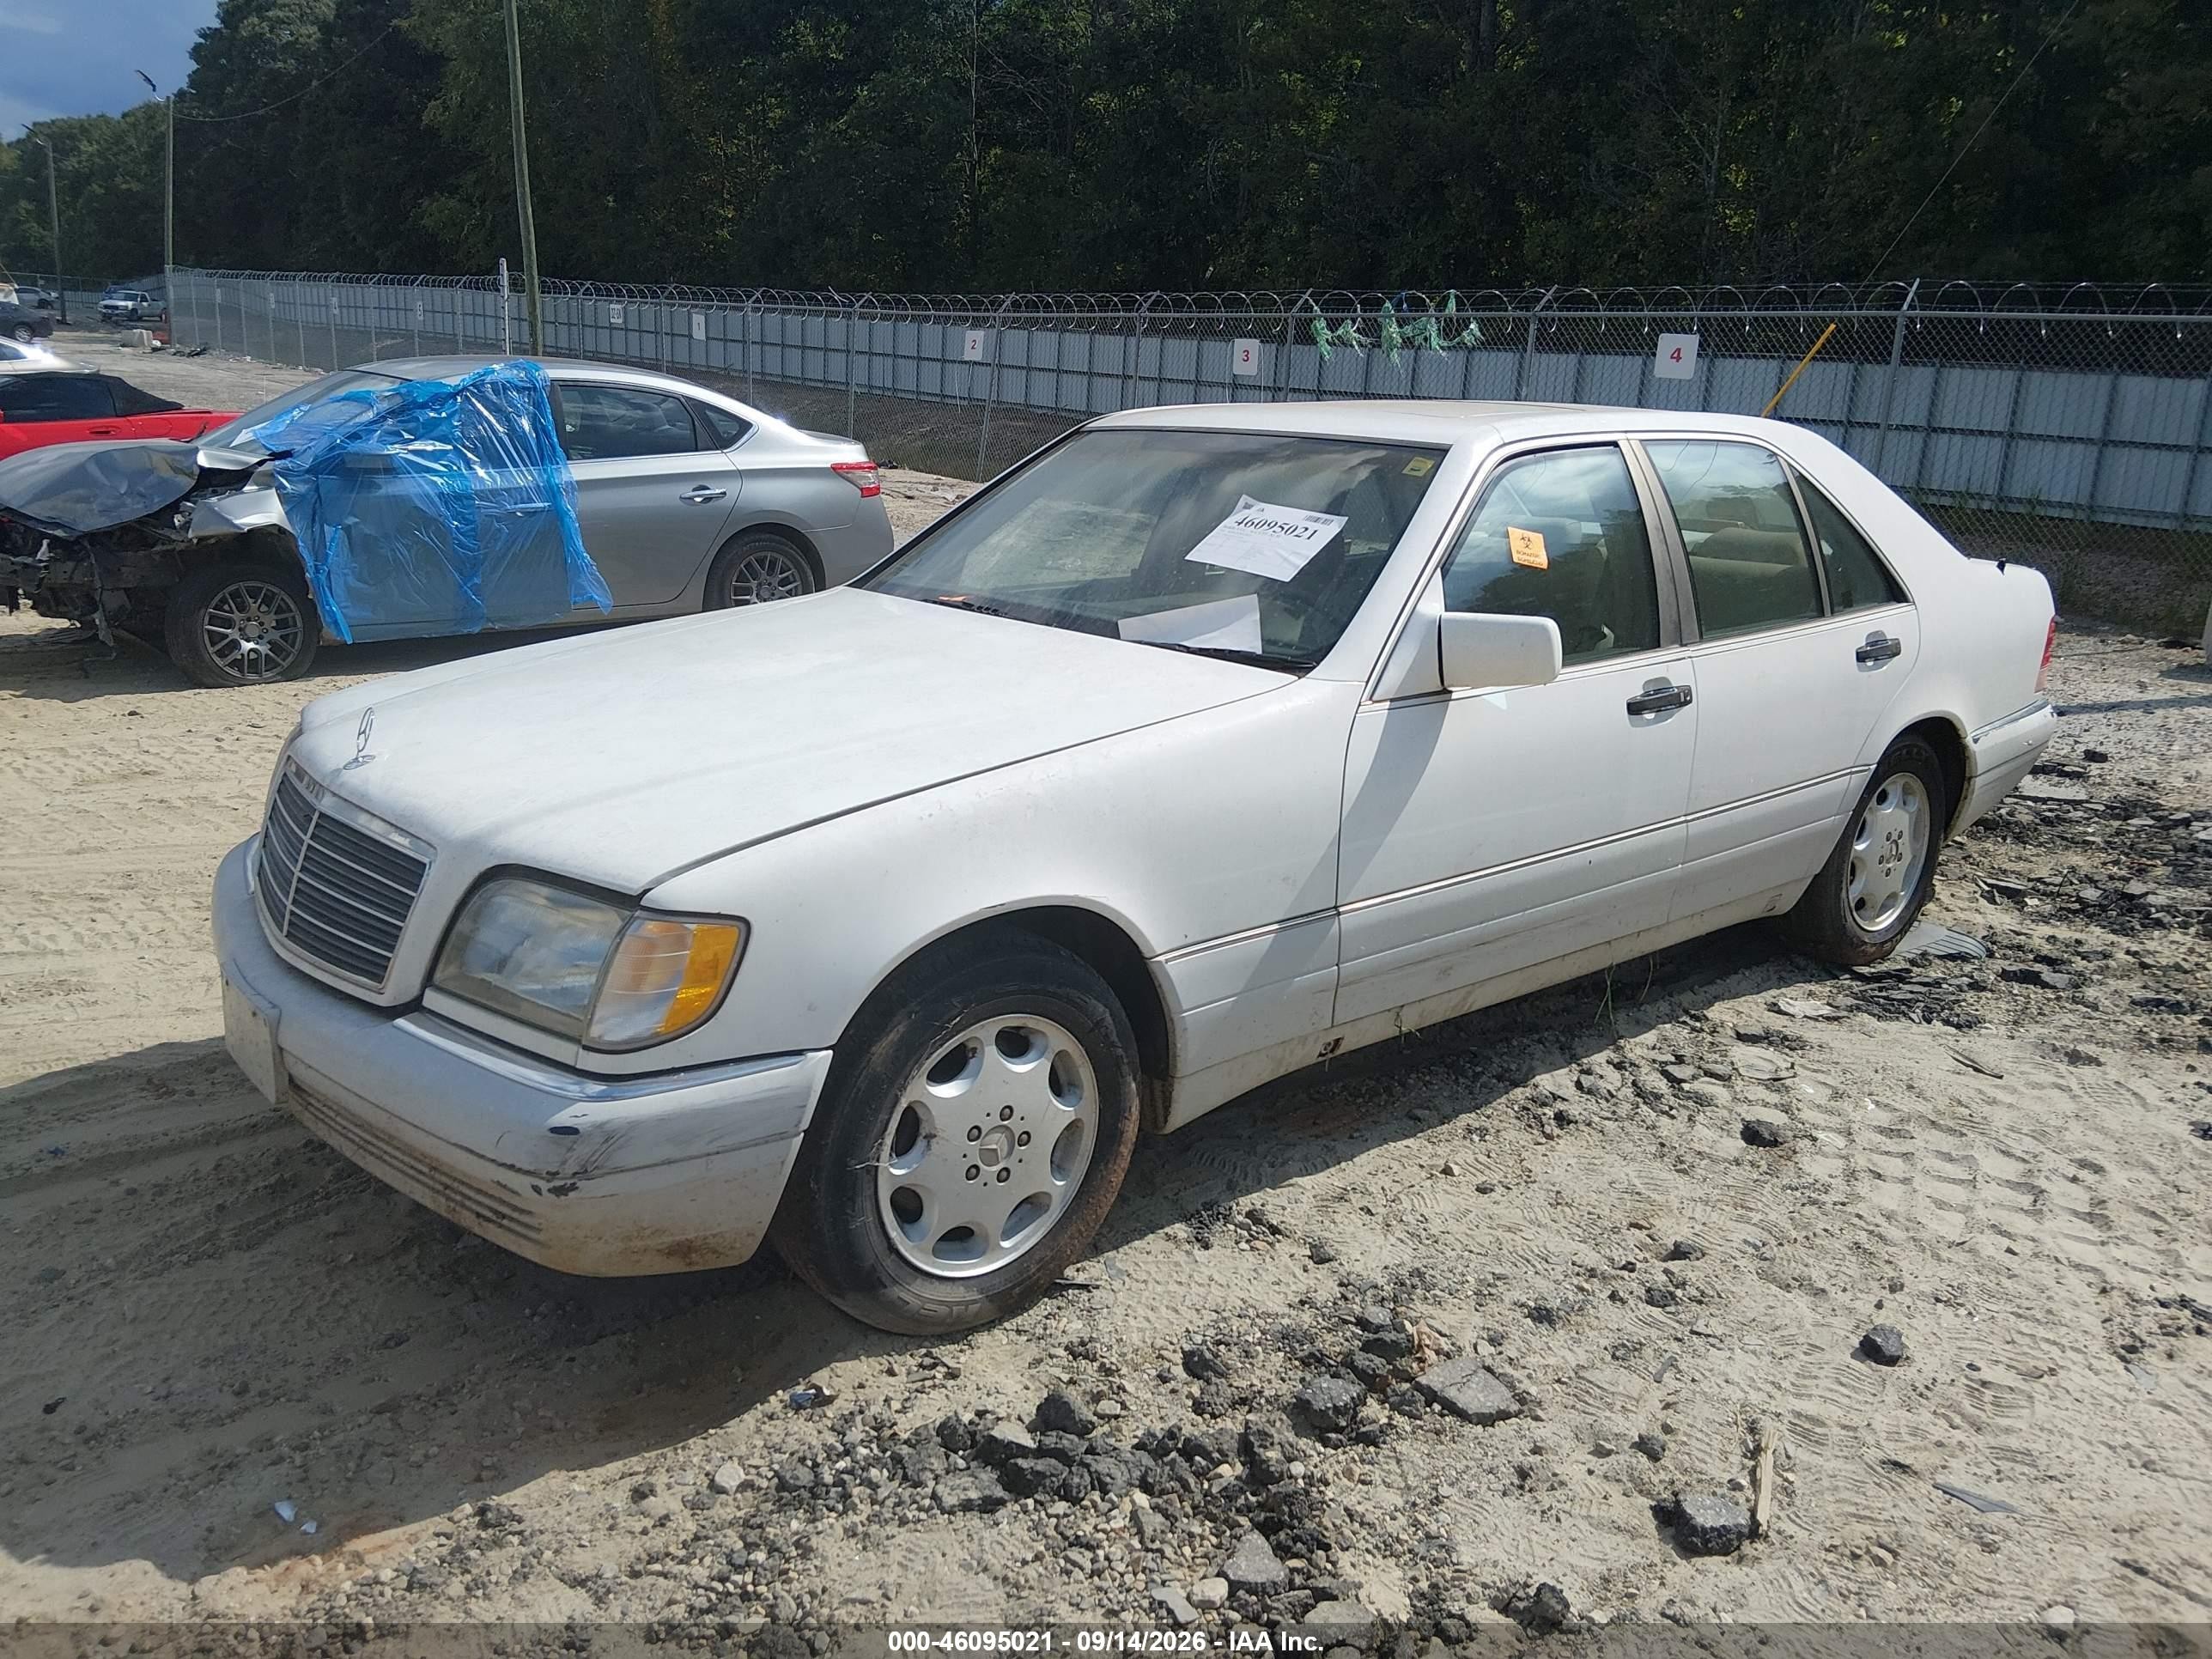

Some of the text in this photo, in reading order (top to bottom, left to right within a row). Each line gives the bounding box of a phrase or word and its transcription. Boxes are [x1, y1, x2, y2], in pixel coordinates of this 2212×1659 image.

[970, 339, 977, 350] 2
[1242, 349, 1250, 362] 3
[1669, 347, 1683, 363] 4
[1235, 515, 1318, 540] 46095021
